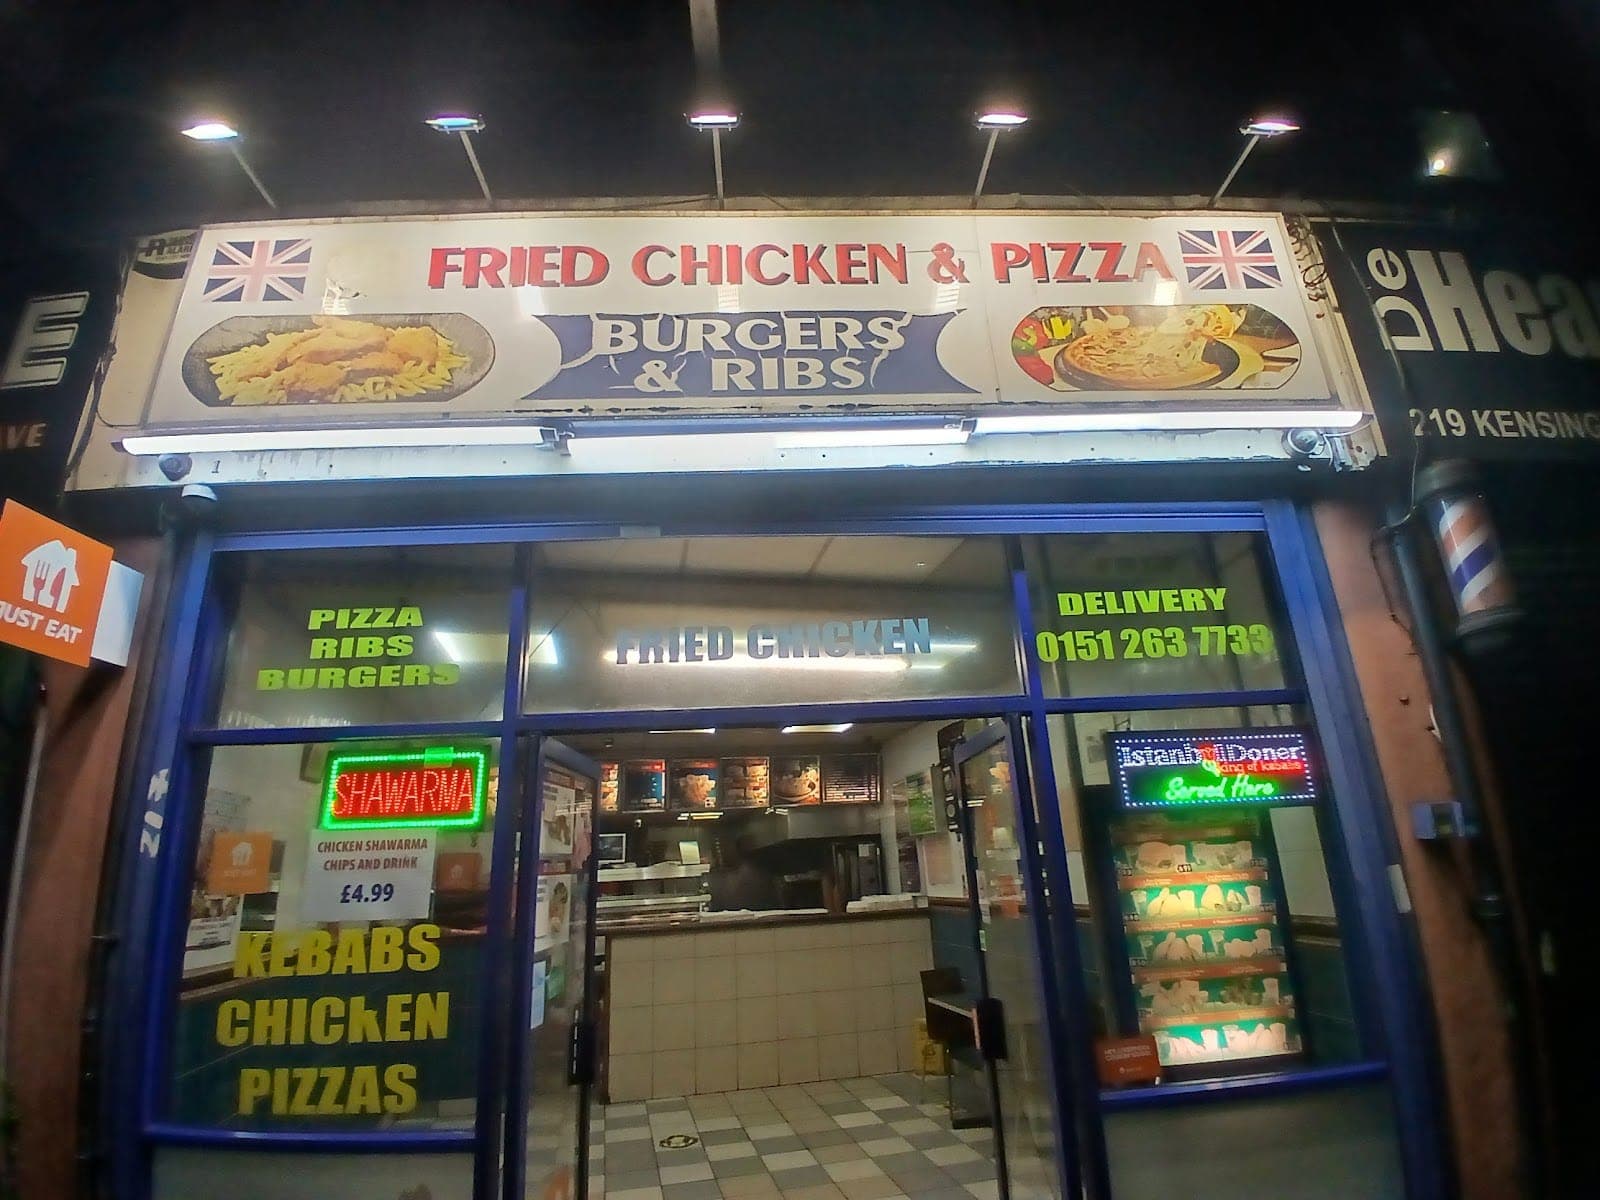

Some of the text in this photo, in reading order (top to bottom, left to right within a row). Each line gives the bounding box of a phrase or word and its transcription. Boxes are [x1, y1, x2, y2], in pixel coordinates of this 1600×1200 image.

[428, 242, 1178, 288] FRIED CHICKEN & PIZZA
[592, 313, 907, 355] BURGERS
[633, 356, 866, 392] & RIBS
[1409, 407, 1467, 437] 219
[1057, 588, 1227, 616] DELIVERY
[45, 617, 83, 645] EAT
[307, 607, 423, 630] PIZZA
[310, 635, 414, 659] RIBS
[616, 617, 932, 665] FRIED CHICKEN
[1036, 624, 1277, 663] 0151 263 7733
[256, 664, 460, 691] BURGERS
[1226, 743, 1302, 762] Doner
[331, 769, 474, 815] SHAWARMA
[1165, 773, 1275, 800] Served Here
[317, 838, 428, 853] CHICKEN SHAWARMA
[323, 856, 418, 872] CHIPS AND DRINK
[340, 883, 394, 904] £4.99
[233, 923, 441, 978] KEBABS
[215, 991, 450, 1047] CHICKEN
[237, 1063, 418, 1116] PIZZAS
